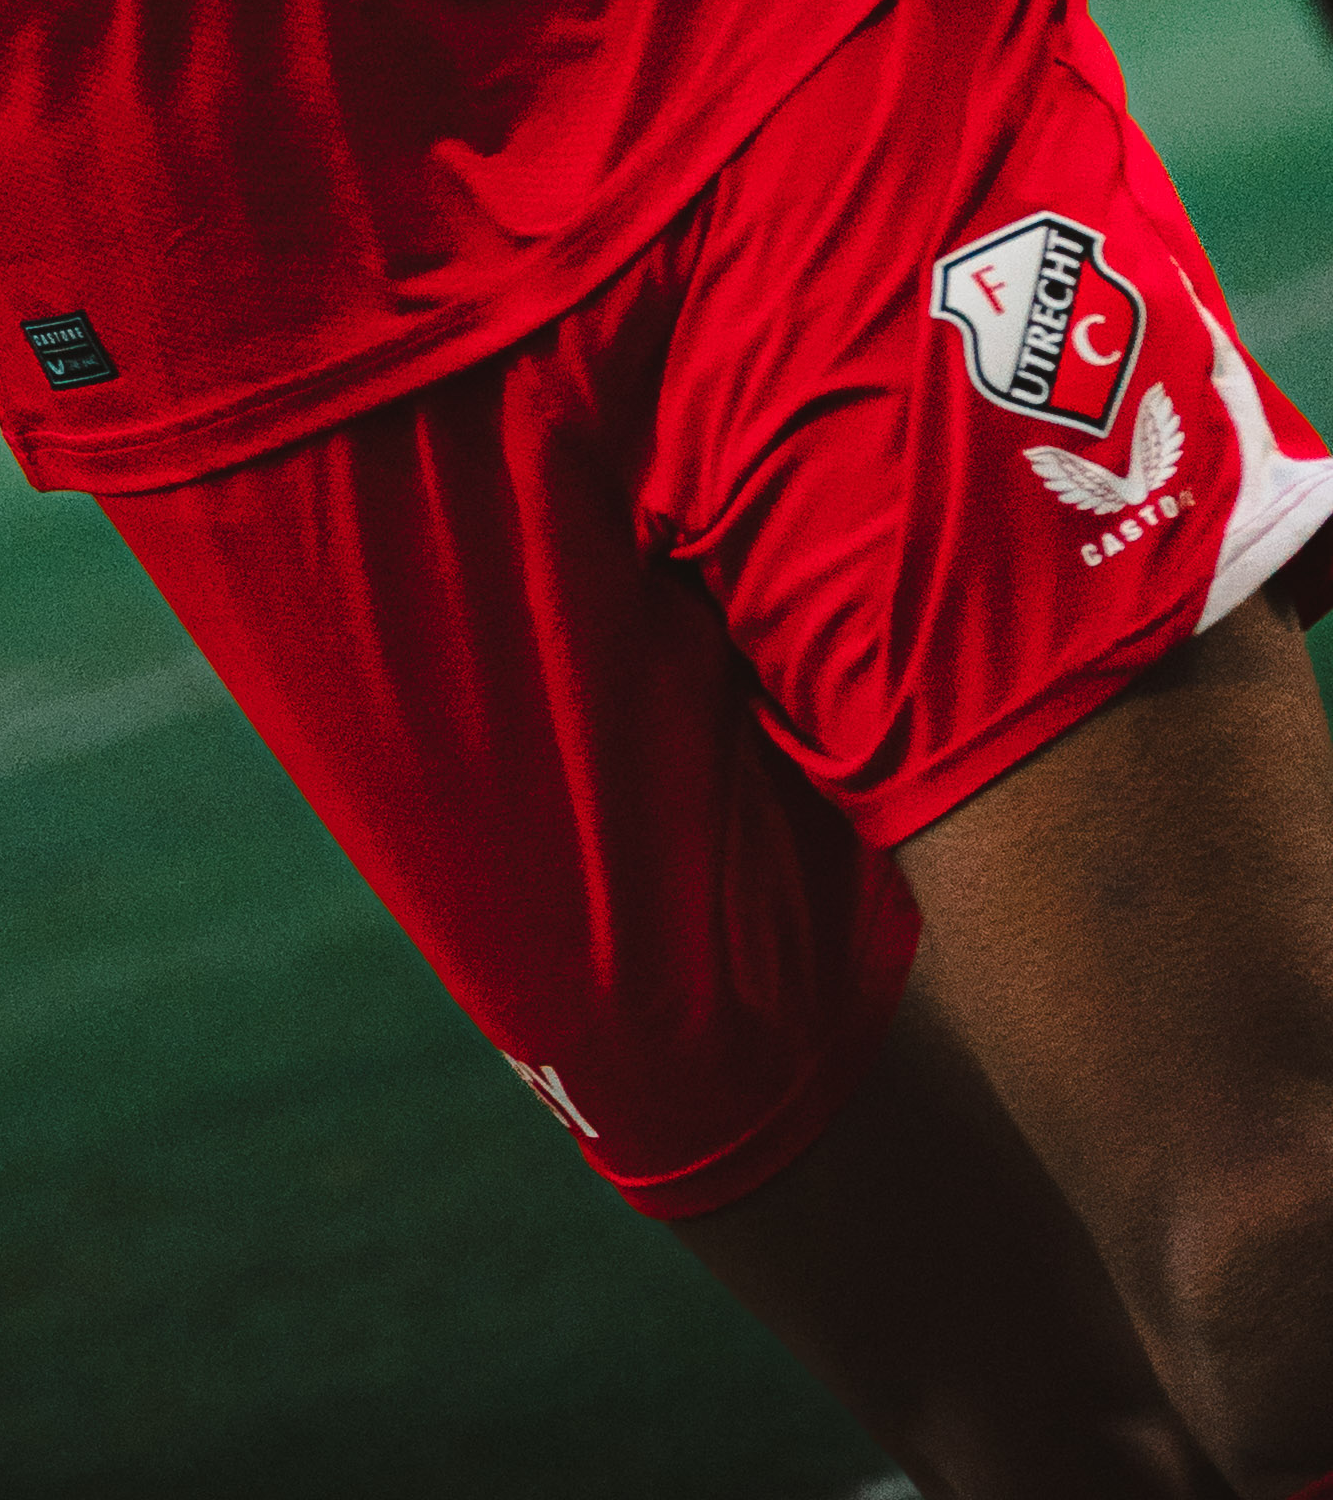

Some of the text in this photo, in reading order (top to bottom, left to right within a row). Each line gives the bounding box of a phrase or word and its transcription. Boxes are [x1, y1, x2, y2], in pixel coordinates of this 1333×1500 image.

[970, 264, 1005, 314] F
[32, 326, 85, 347] CASTORE
[1011, 229, 1085, 405] UTRECHT
[1071, 314, 1122, 367] C
